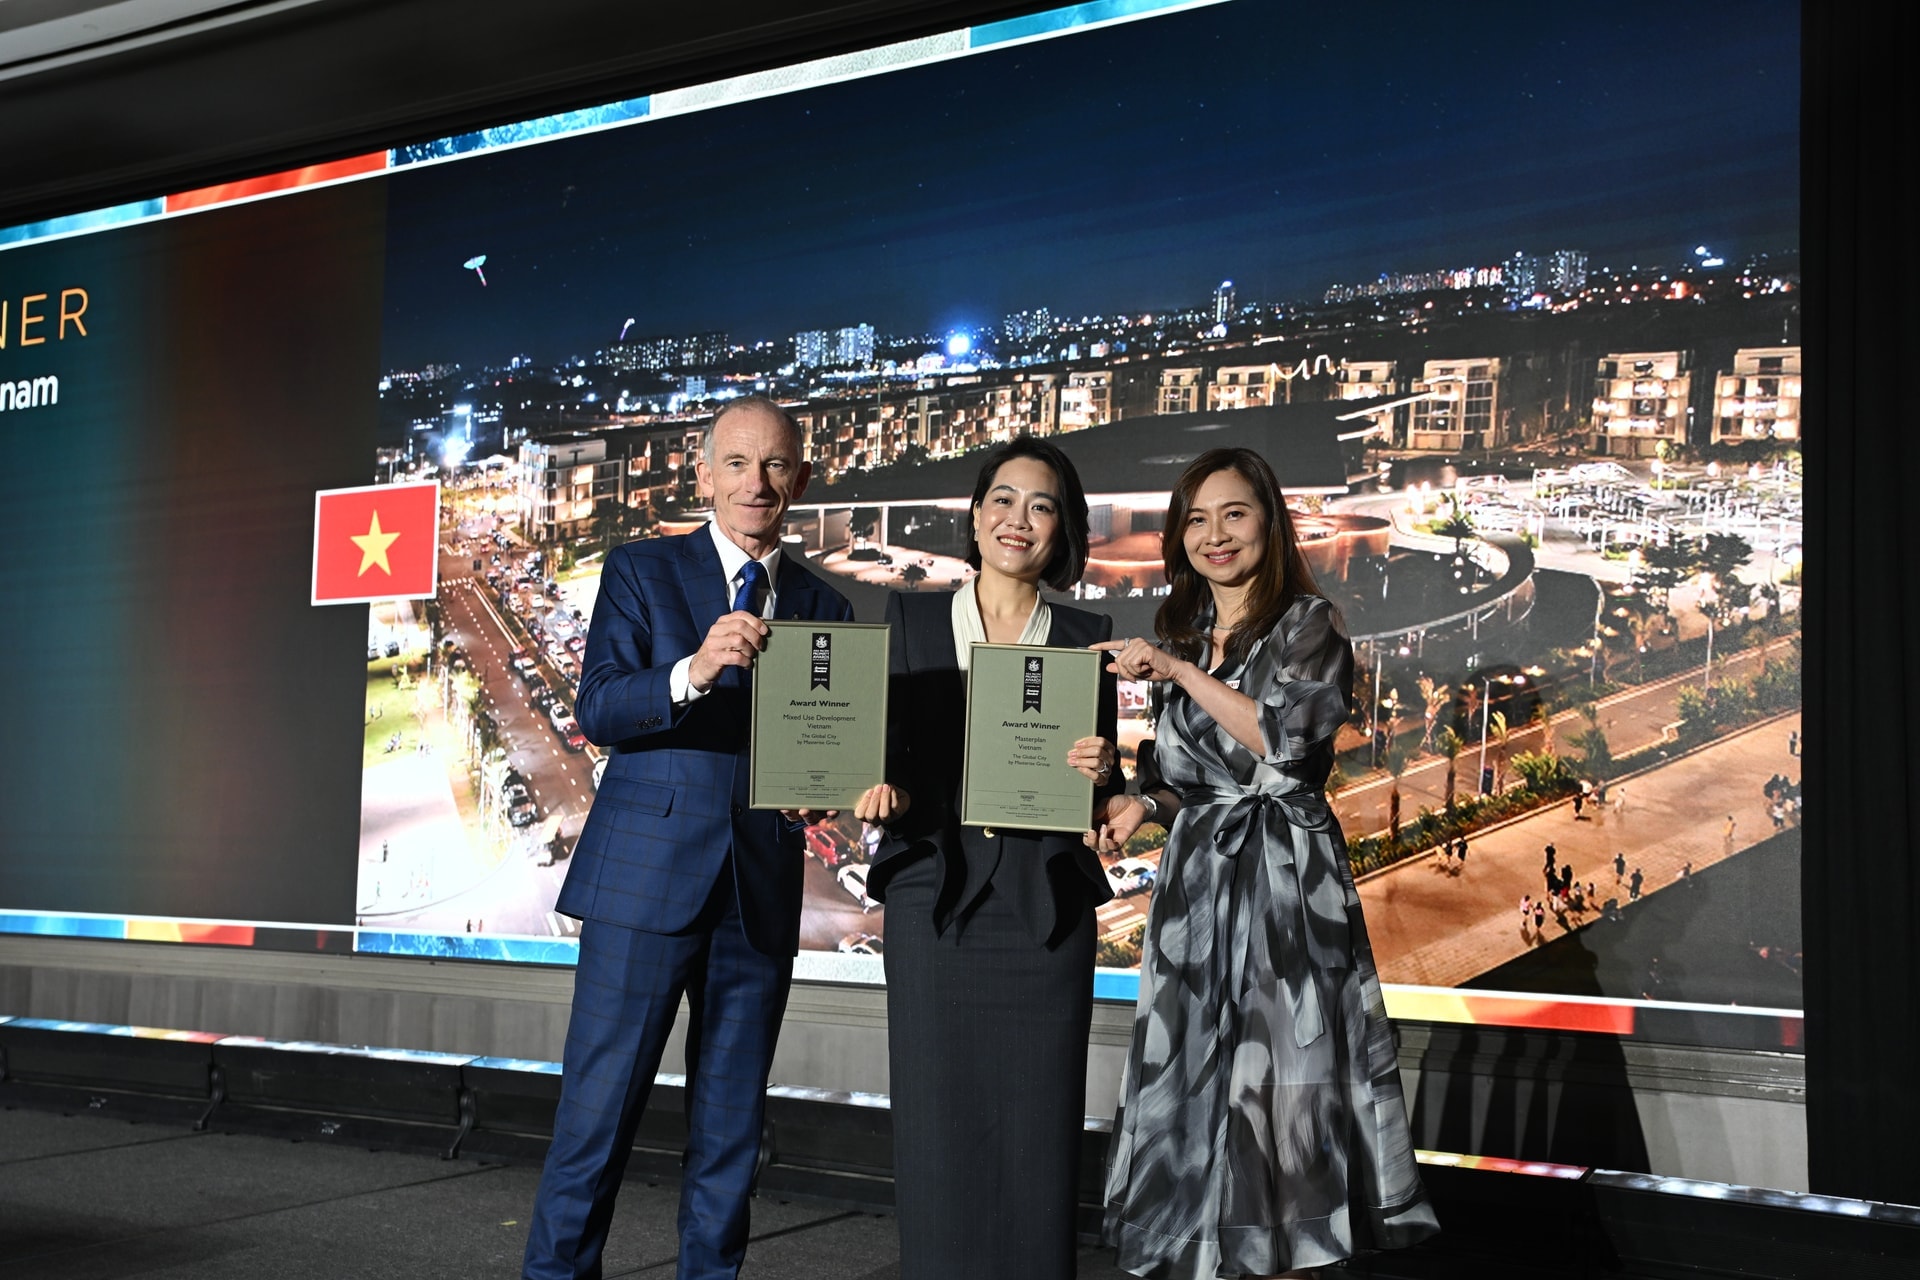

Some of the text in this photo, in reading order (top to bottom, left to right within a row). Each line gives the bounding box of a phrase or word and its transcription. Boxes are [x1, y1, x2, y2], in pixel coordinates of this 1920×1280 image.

[1002, 720, 1061, 730] Award Winner
[1014, 735, 1046, 743] Masterplan
